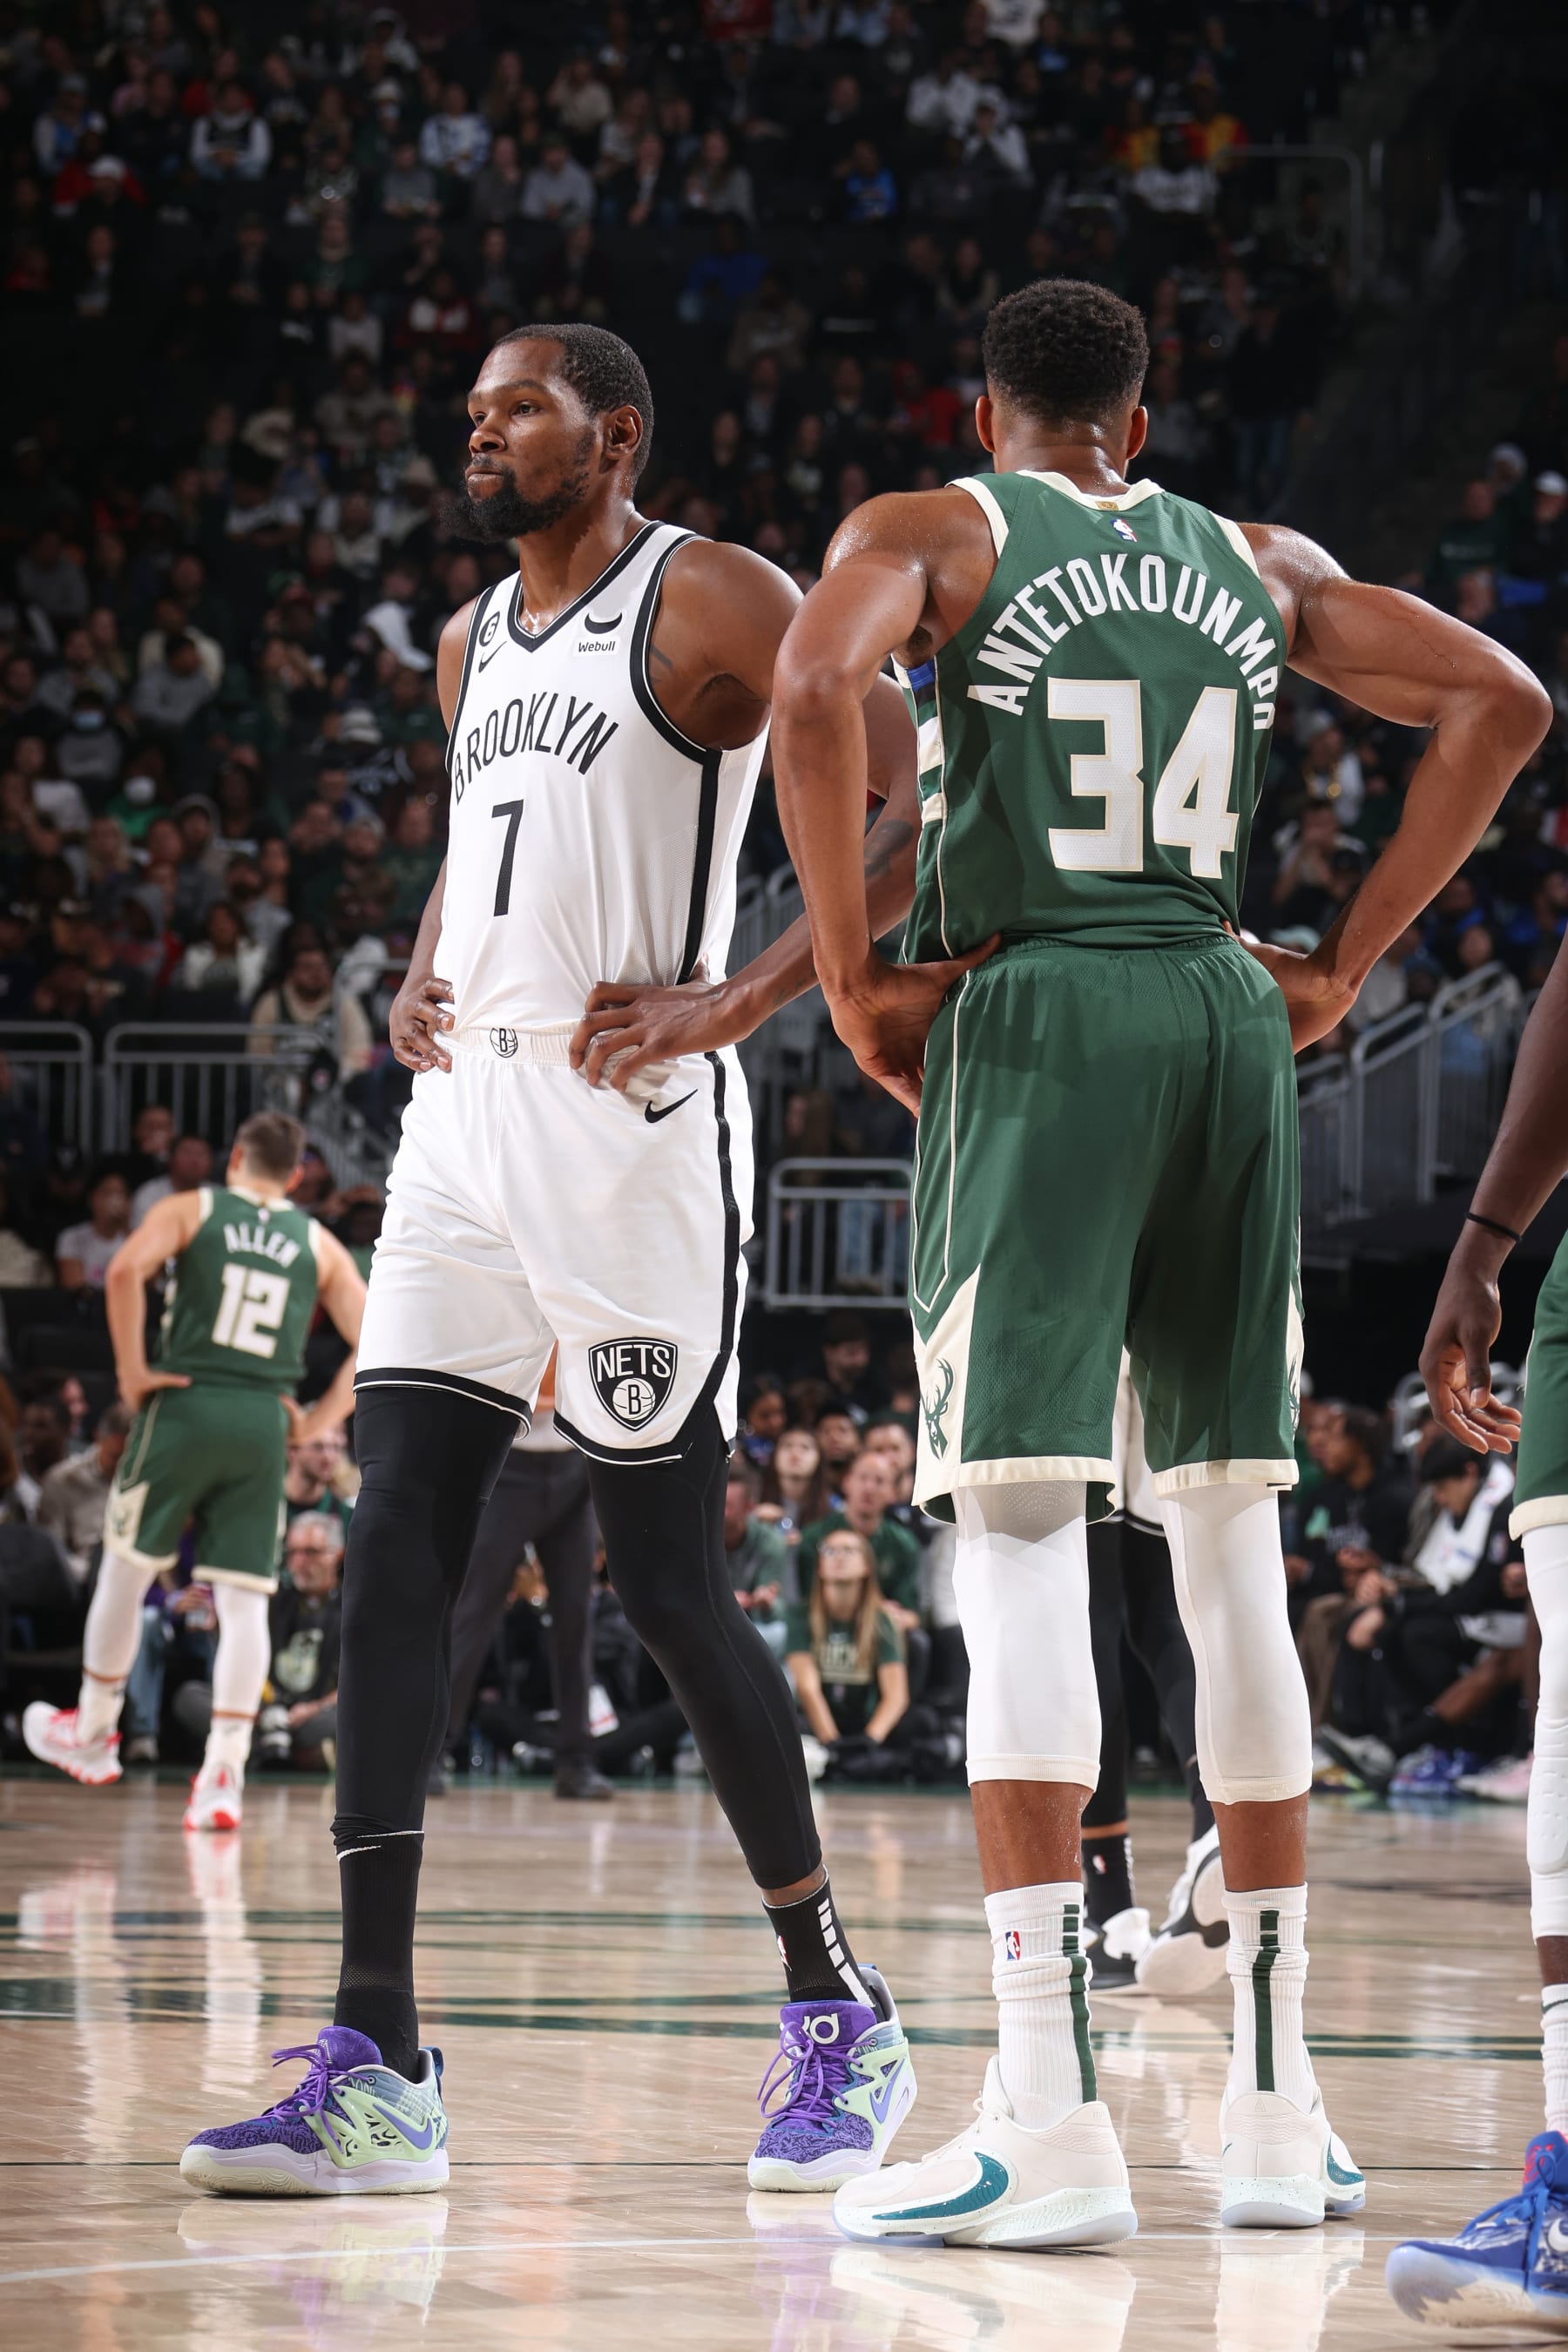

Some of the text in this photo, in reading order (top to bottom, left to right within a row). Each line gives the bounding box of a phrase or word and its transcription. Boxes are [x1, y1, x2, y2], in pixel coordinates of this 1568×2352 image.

[578, 640, 617, 652] Webull
[967, 553, 1278, 730] ANTETOKOUNMPO
[451, 692, 618, 806] BROOKLYN
[1047, 677, 1240, 880] 34
[490, 799, 524, 917] 7
[223, 1223, 301, 1267] ALLEN
[211, 1262, 291, 1360] 12
[597, 1344, 671, 1382] NETS
[627, 1384, 641, 1415] B
